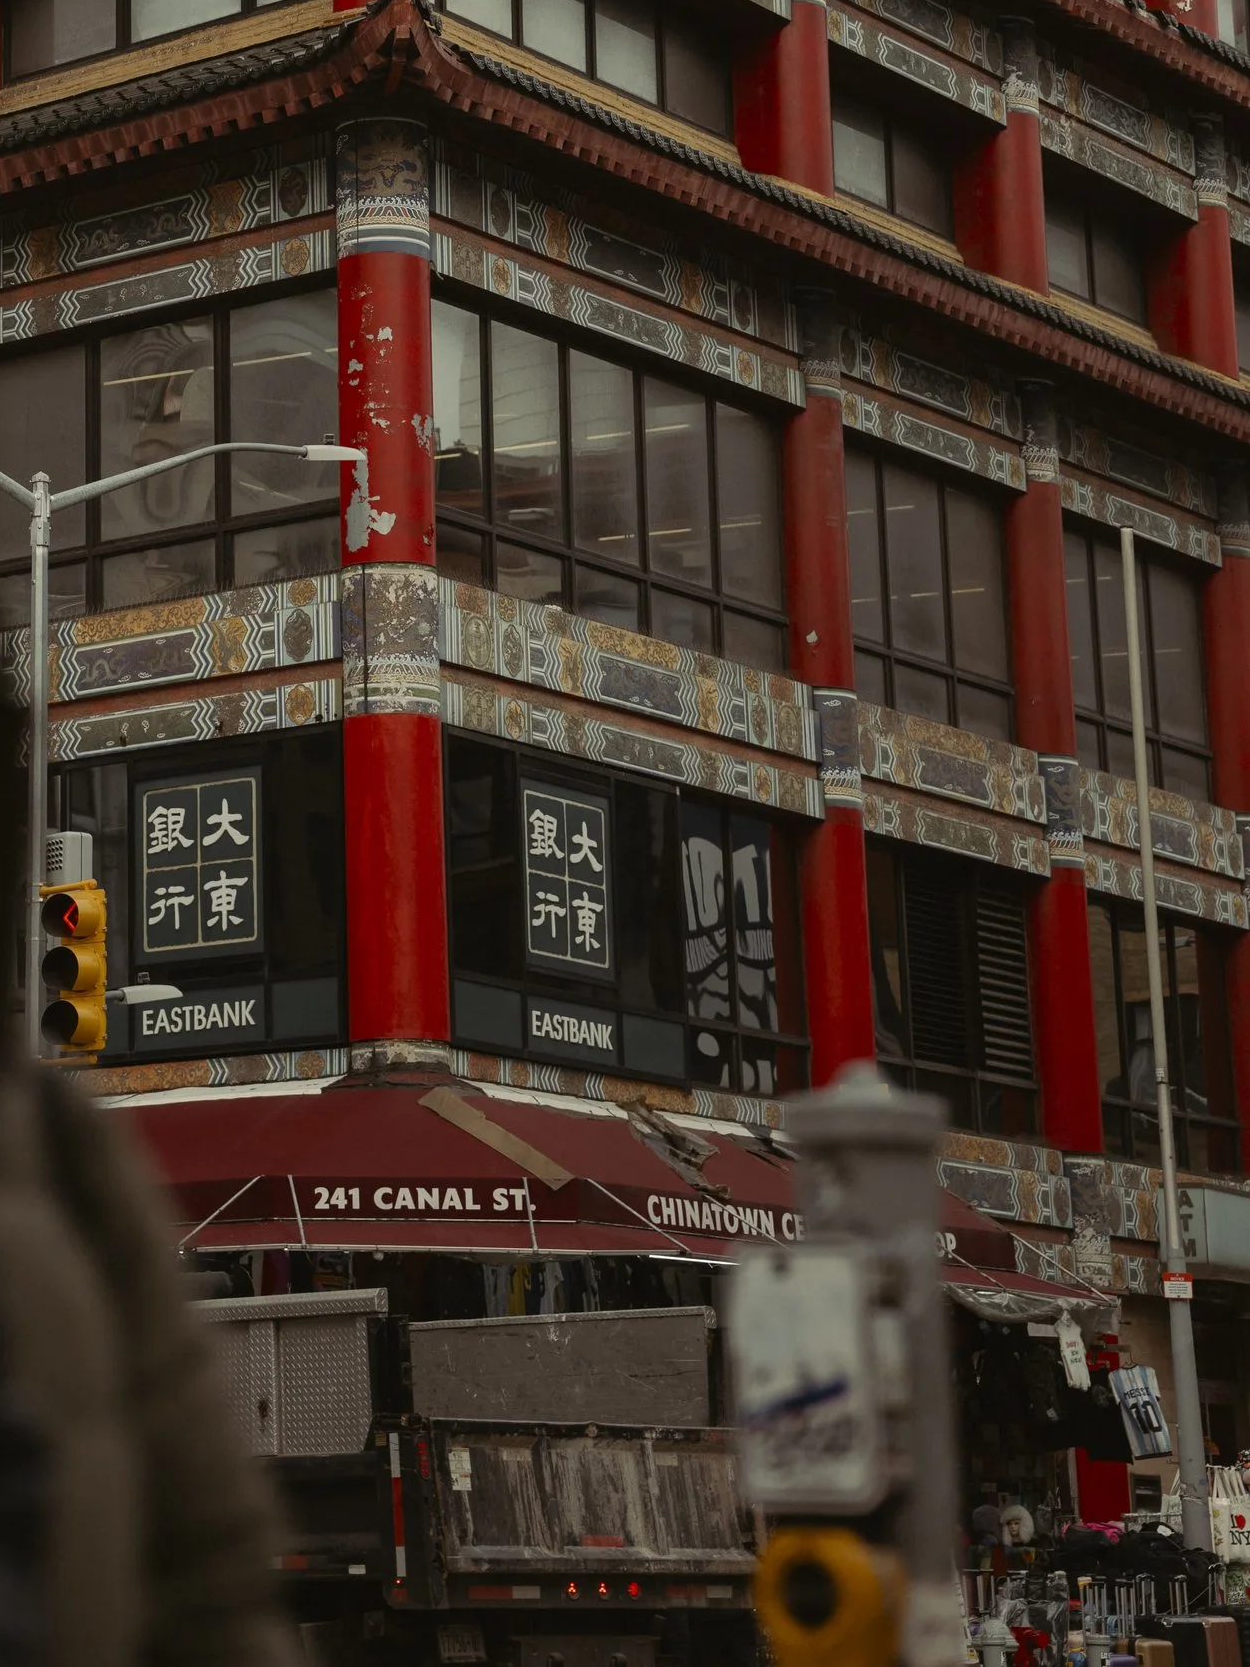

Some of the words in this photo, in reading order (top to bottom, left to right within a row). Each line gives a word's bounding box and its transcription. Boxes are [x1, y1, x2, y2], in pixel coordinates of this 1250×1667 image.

[141, 998, 257, 1037] EASTBANK
[530, 1009, 614, 1051] EASTBANK
[313, 1186, 362, 1210] 241
[372, 1186, 482, 1211] CANAL
[491, 1186, 537, 1212] ST.
[646, 1194, 777, 1238] CHINATOWN
[1177, 1189, 1198, 1258] ATM
[1122, 1386, 1151, 1400] MESSI
[1128, 1400, 1163, 1435] 10
[1229, 1513, 1238, 1529] I
[1229, 1530, 1250, 1546] NY
